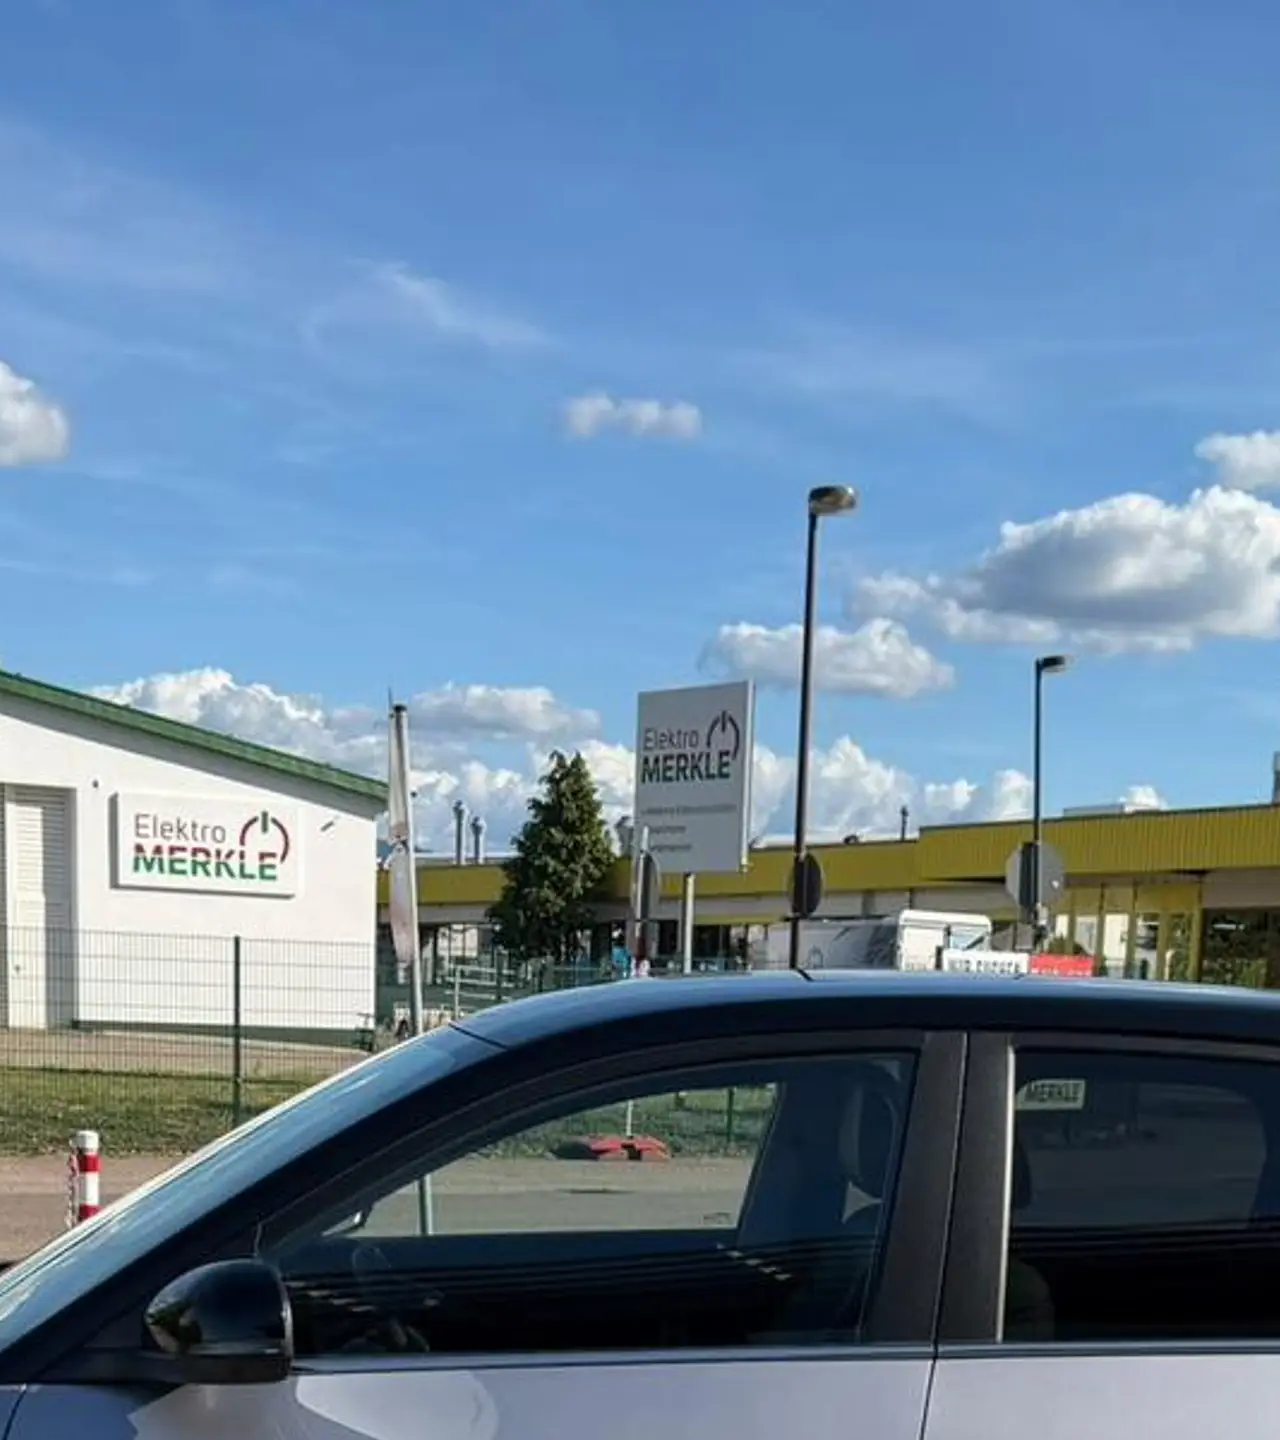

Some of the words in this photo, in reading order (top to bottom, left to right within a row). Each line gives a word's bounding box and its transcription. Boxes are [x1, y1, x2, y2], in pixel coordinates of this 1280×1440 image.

[644, 727, 699, 750] Elektro
[642, 751, 730, 783] MERKLE
[134, 813, 226, 844] Elektro
[132, 843, 278, 881] MERKLE
